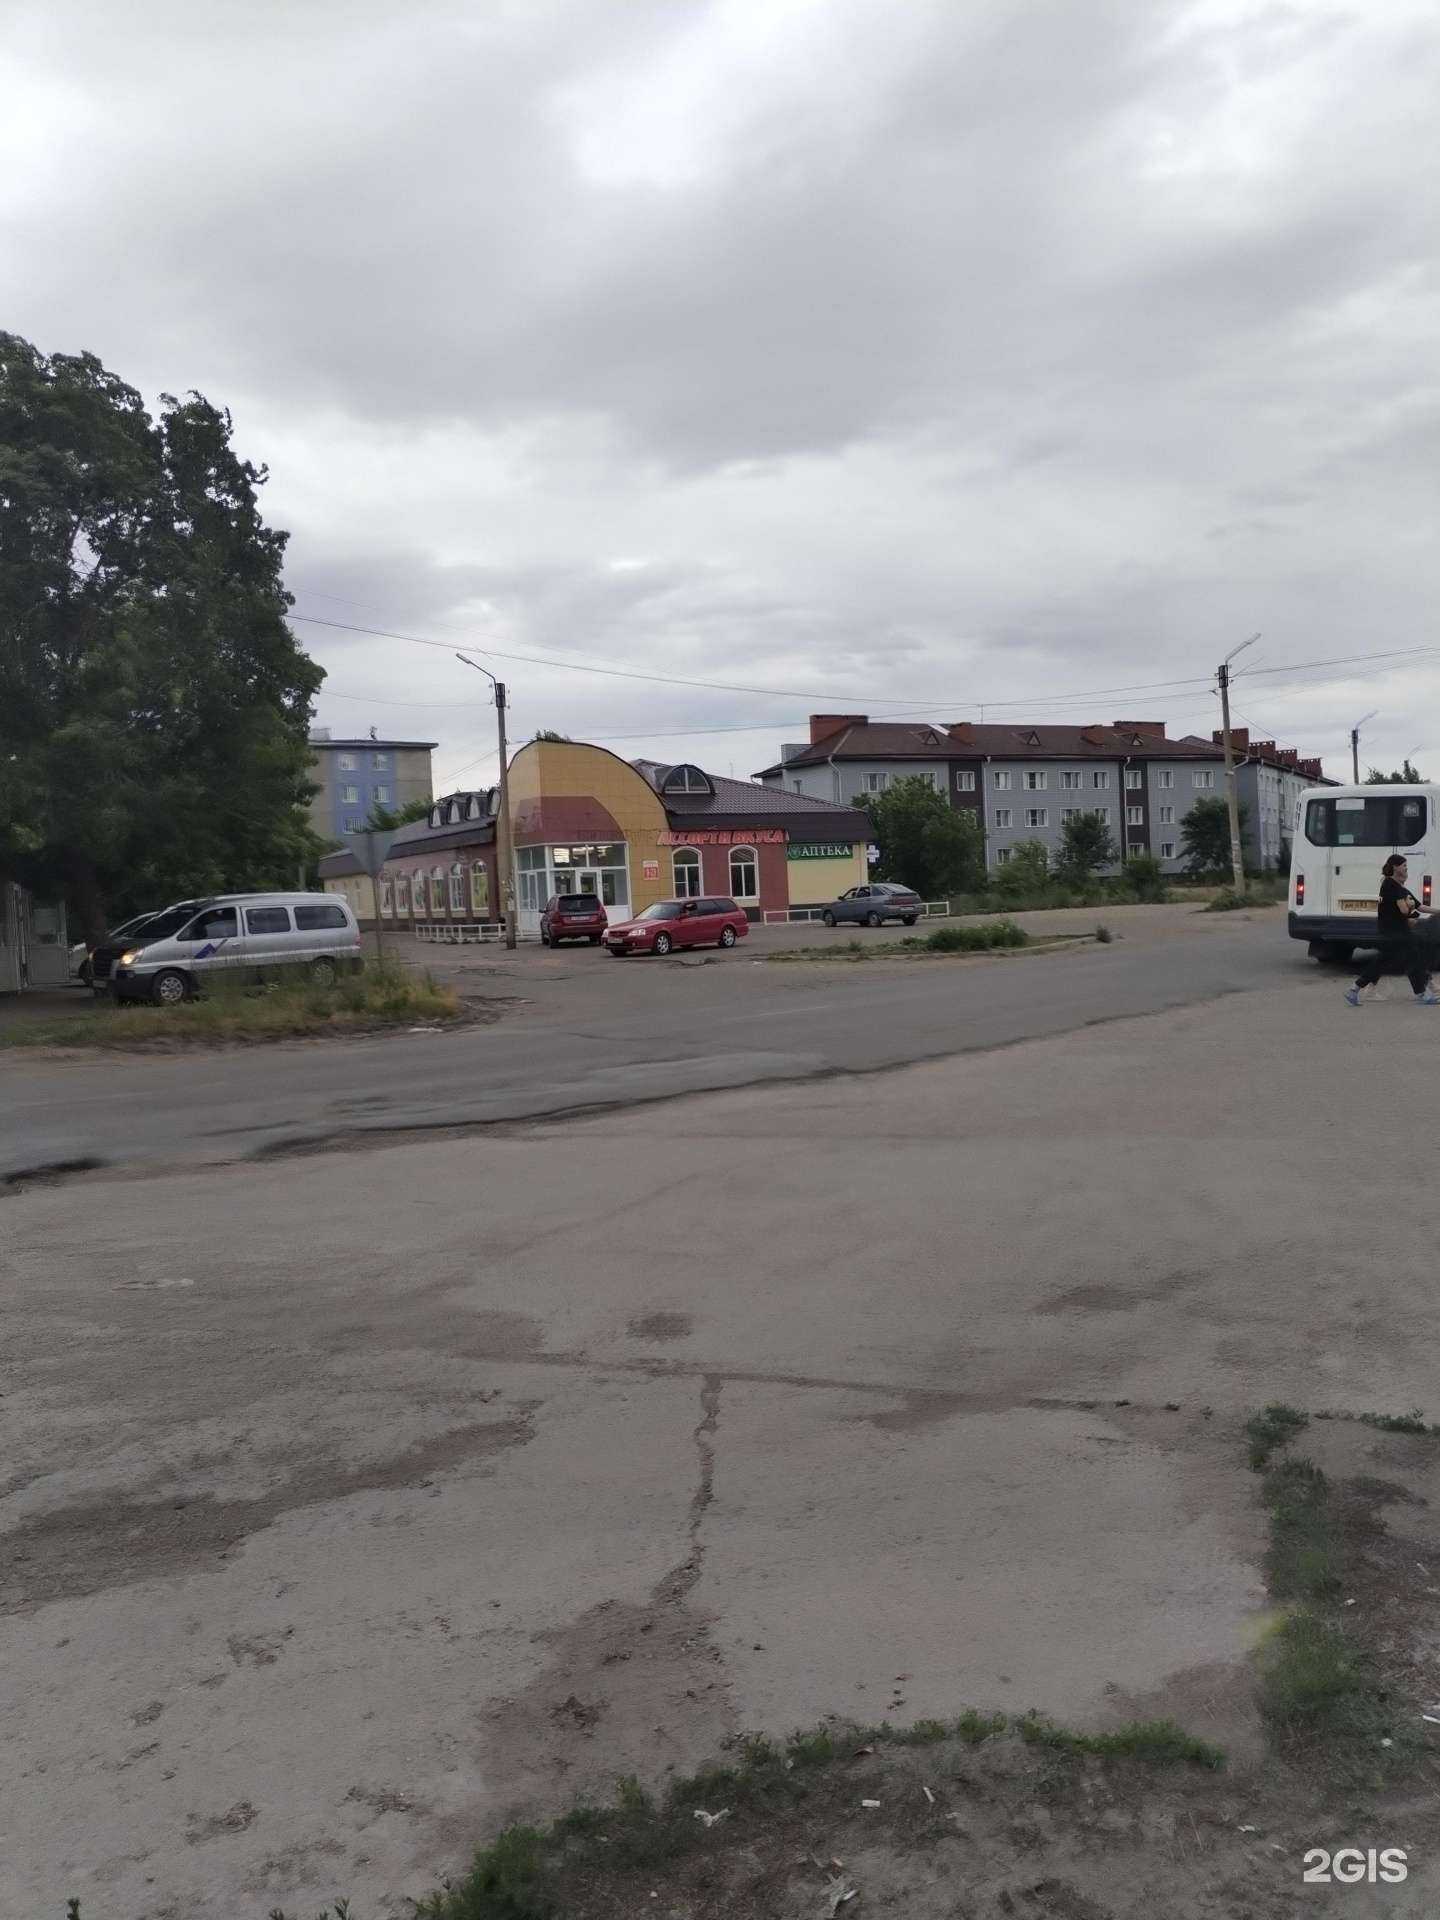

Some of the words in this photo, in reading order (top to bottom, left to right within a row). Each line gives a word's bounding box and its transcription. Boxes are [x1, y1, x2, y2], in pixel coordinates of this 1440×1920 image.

[656, 830, 731, 845] АССОРТИ
[732, 829, 784, 844] ВКУСА
[801, 845, 850, 857] АПТЕКА
